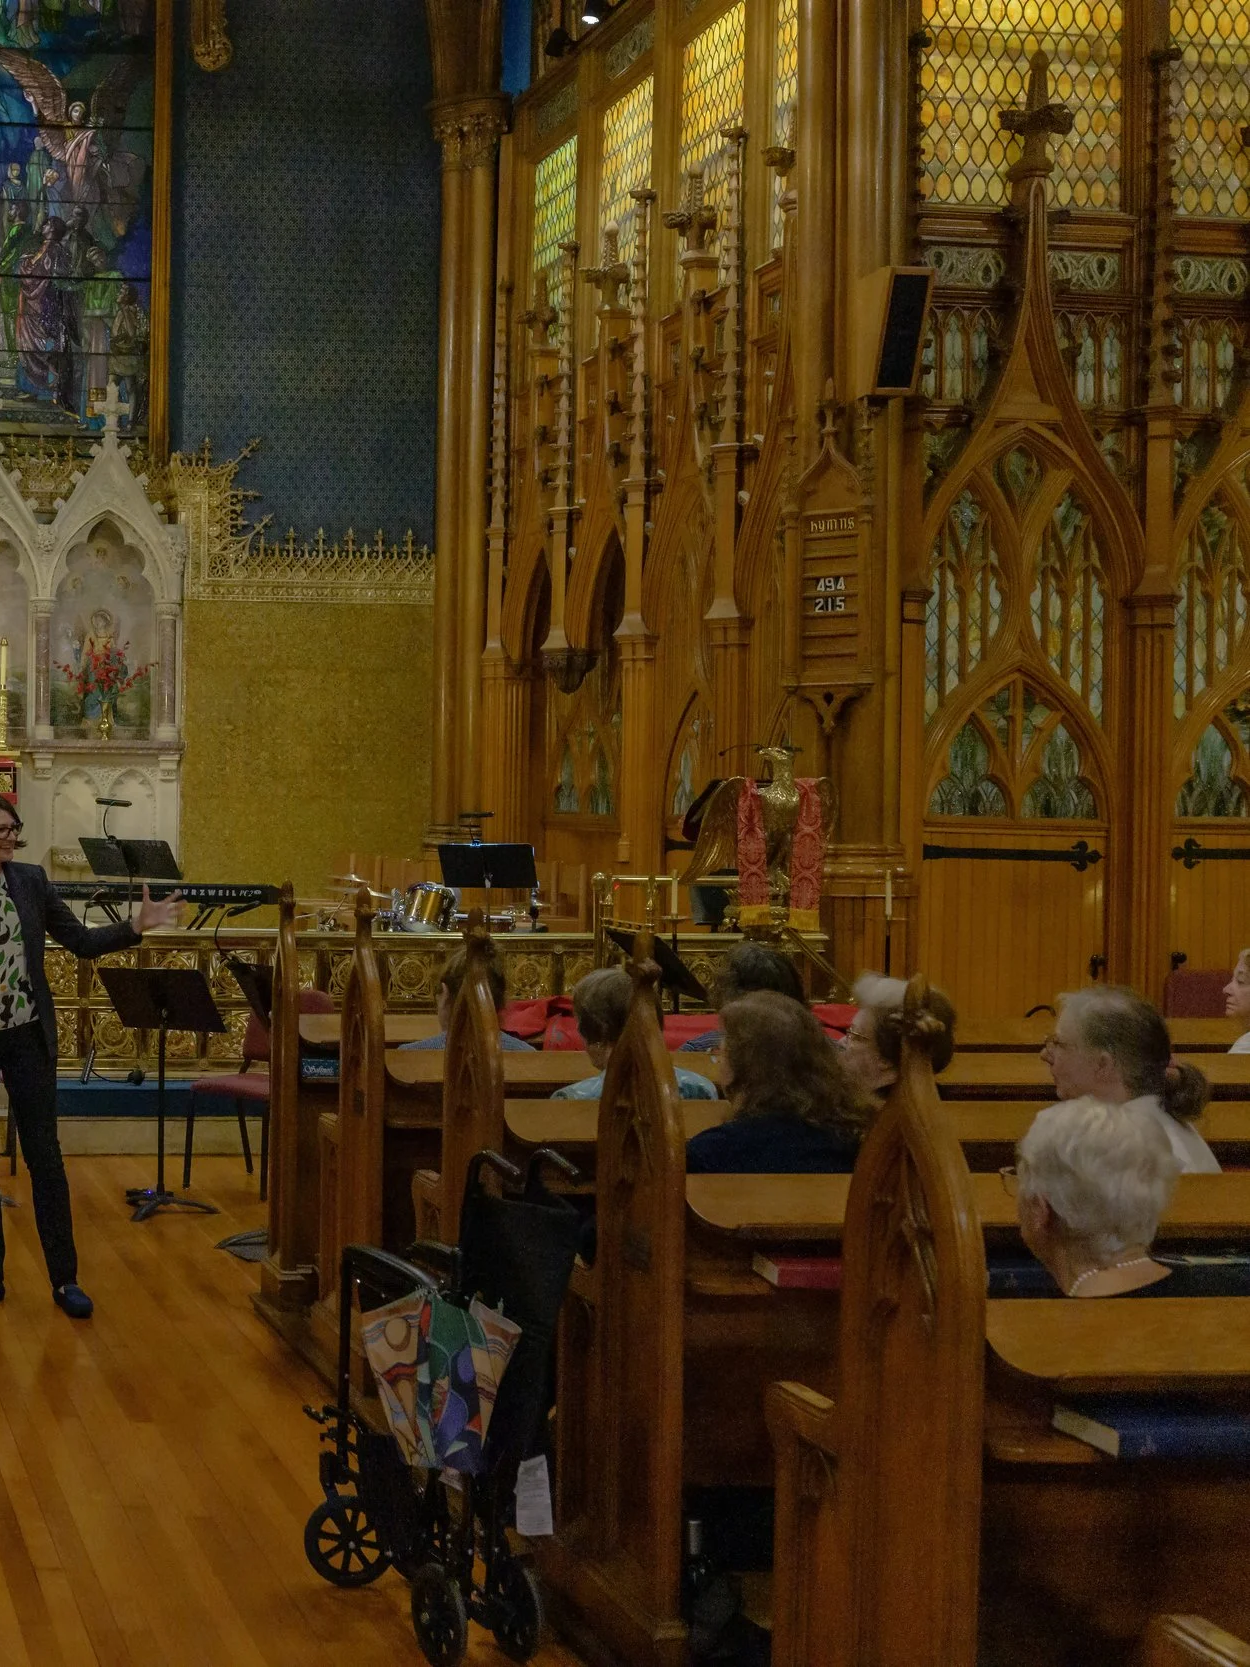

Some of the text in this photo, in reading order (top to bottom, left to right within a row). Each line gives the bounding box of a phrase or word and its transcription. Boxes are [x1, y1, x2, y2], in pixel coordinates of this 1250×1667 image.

[816, 577, 846, 592] 494
[815, 597, 845, 613] 215
[175, 888, 237, 897] URZWEIL
